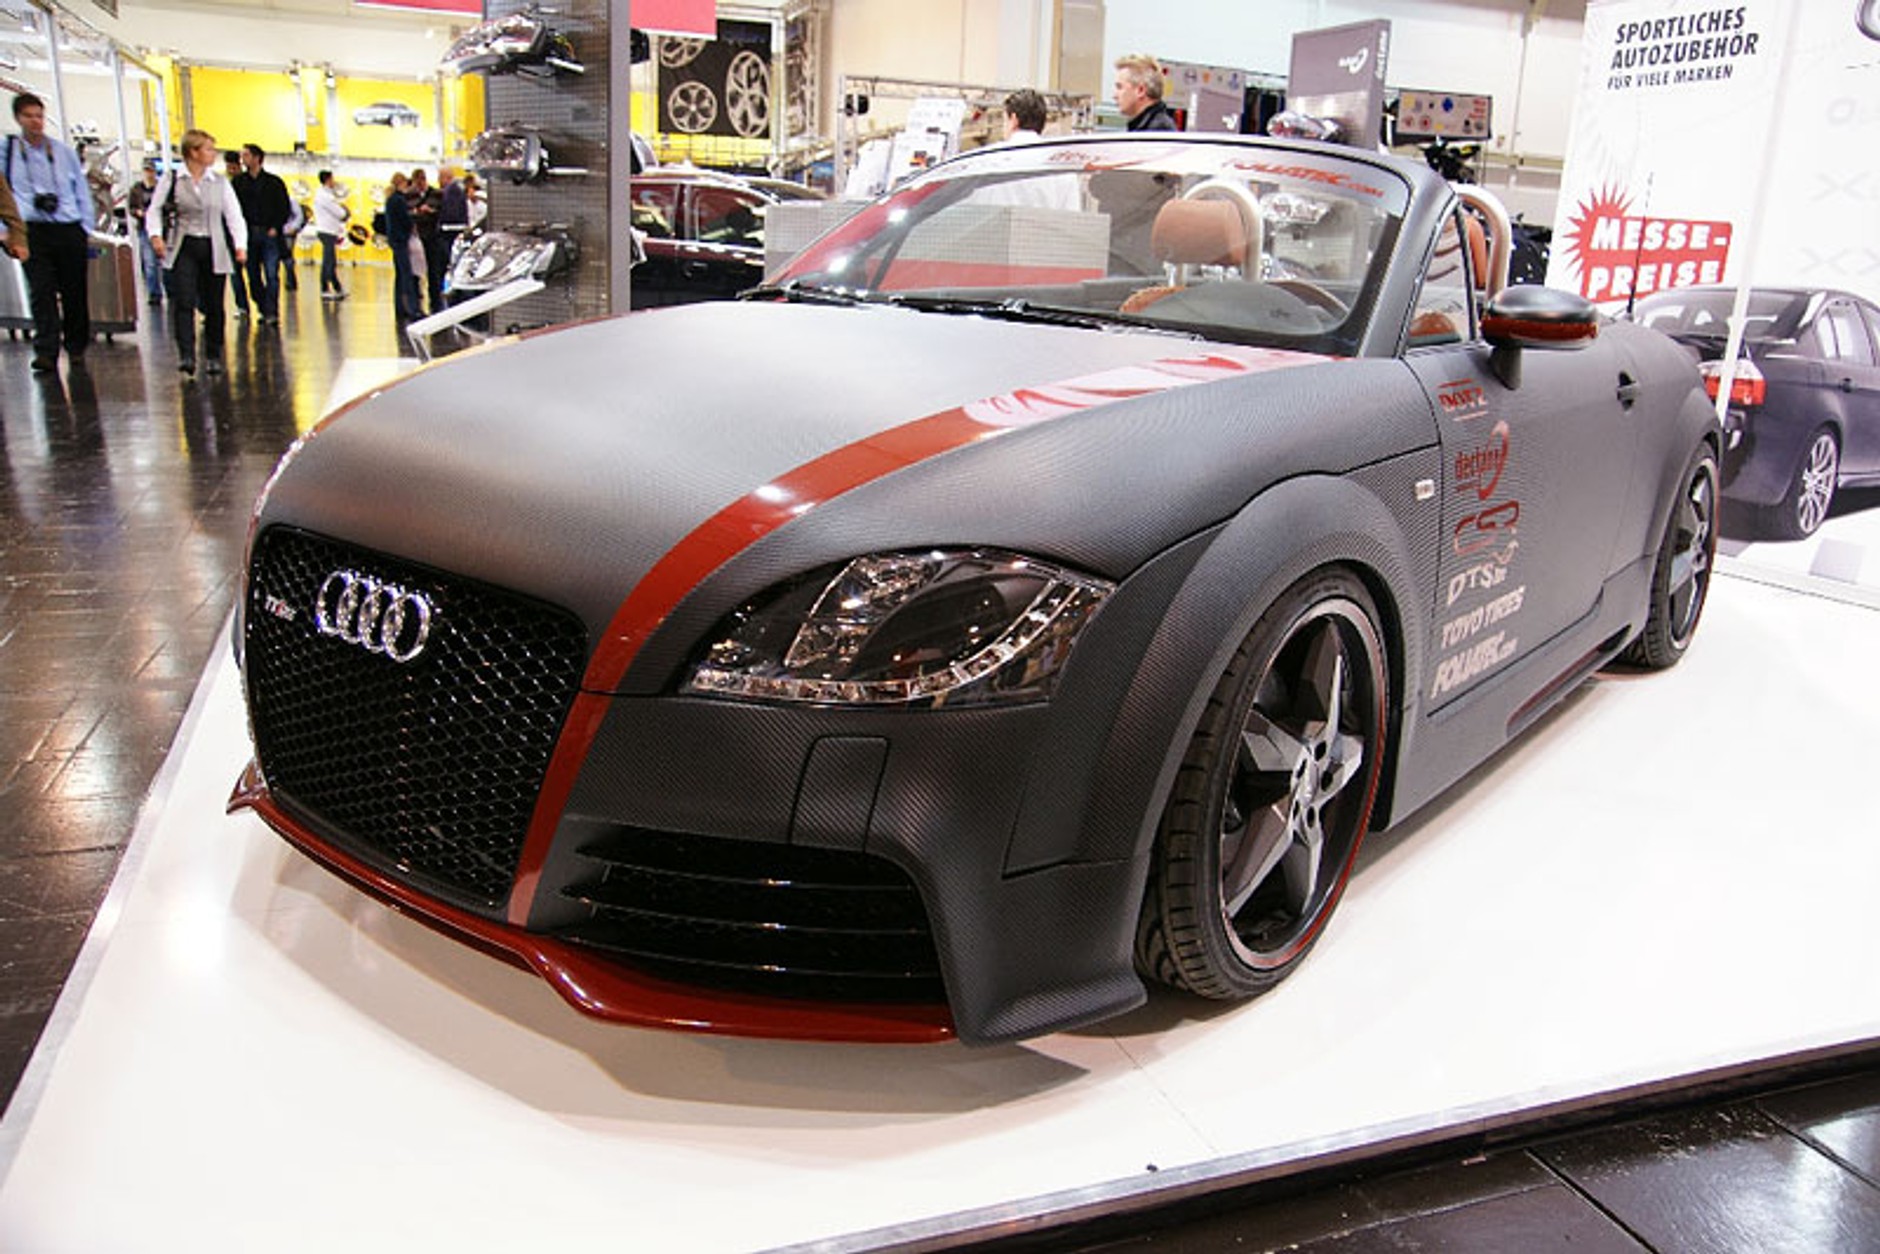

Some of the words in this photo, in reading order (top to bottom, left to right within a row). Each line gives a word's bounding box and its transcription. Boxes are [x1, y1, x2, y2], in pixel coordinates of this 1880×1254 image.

[1614, 6, 1747, 45] SPORTLICHES
[1610, 31, 1760, 71] AUTOZUBEHÖR
[1607, 73, 1632, 91] FÜR
[1635, 70, 1670, 88] VIELE
[1673, 64, 1734, 83] MARKEN
[1589, 215, 1728, 251] MESSE-
[1586, 259, 1721, 300] PREISE
